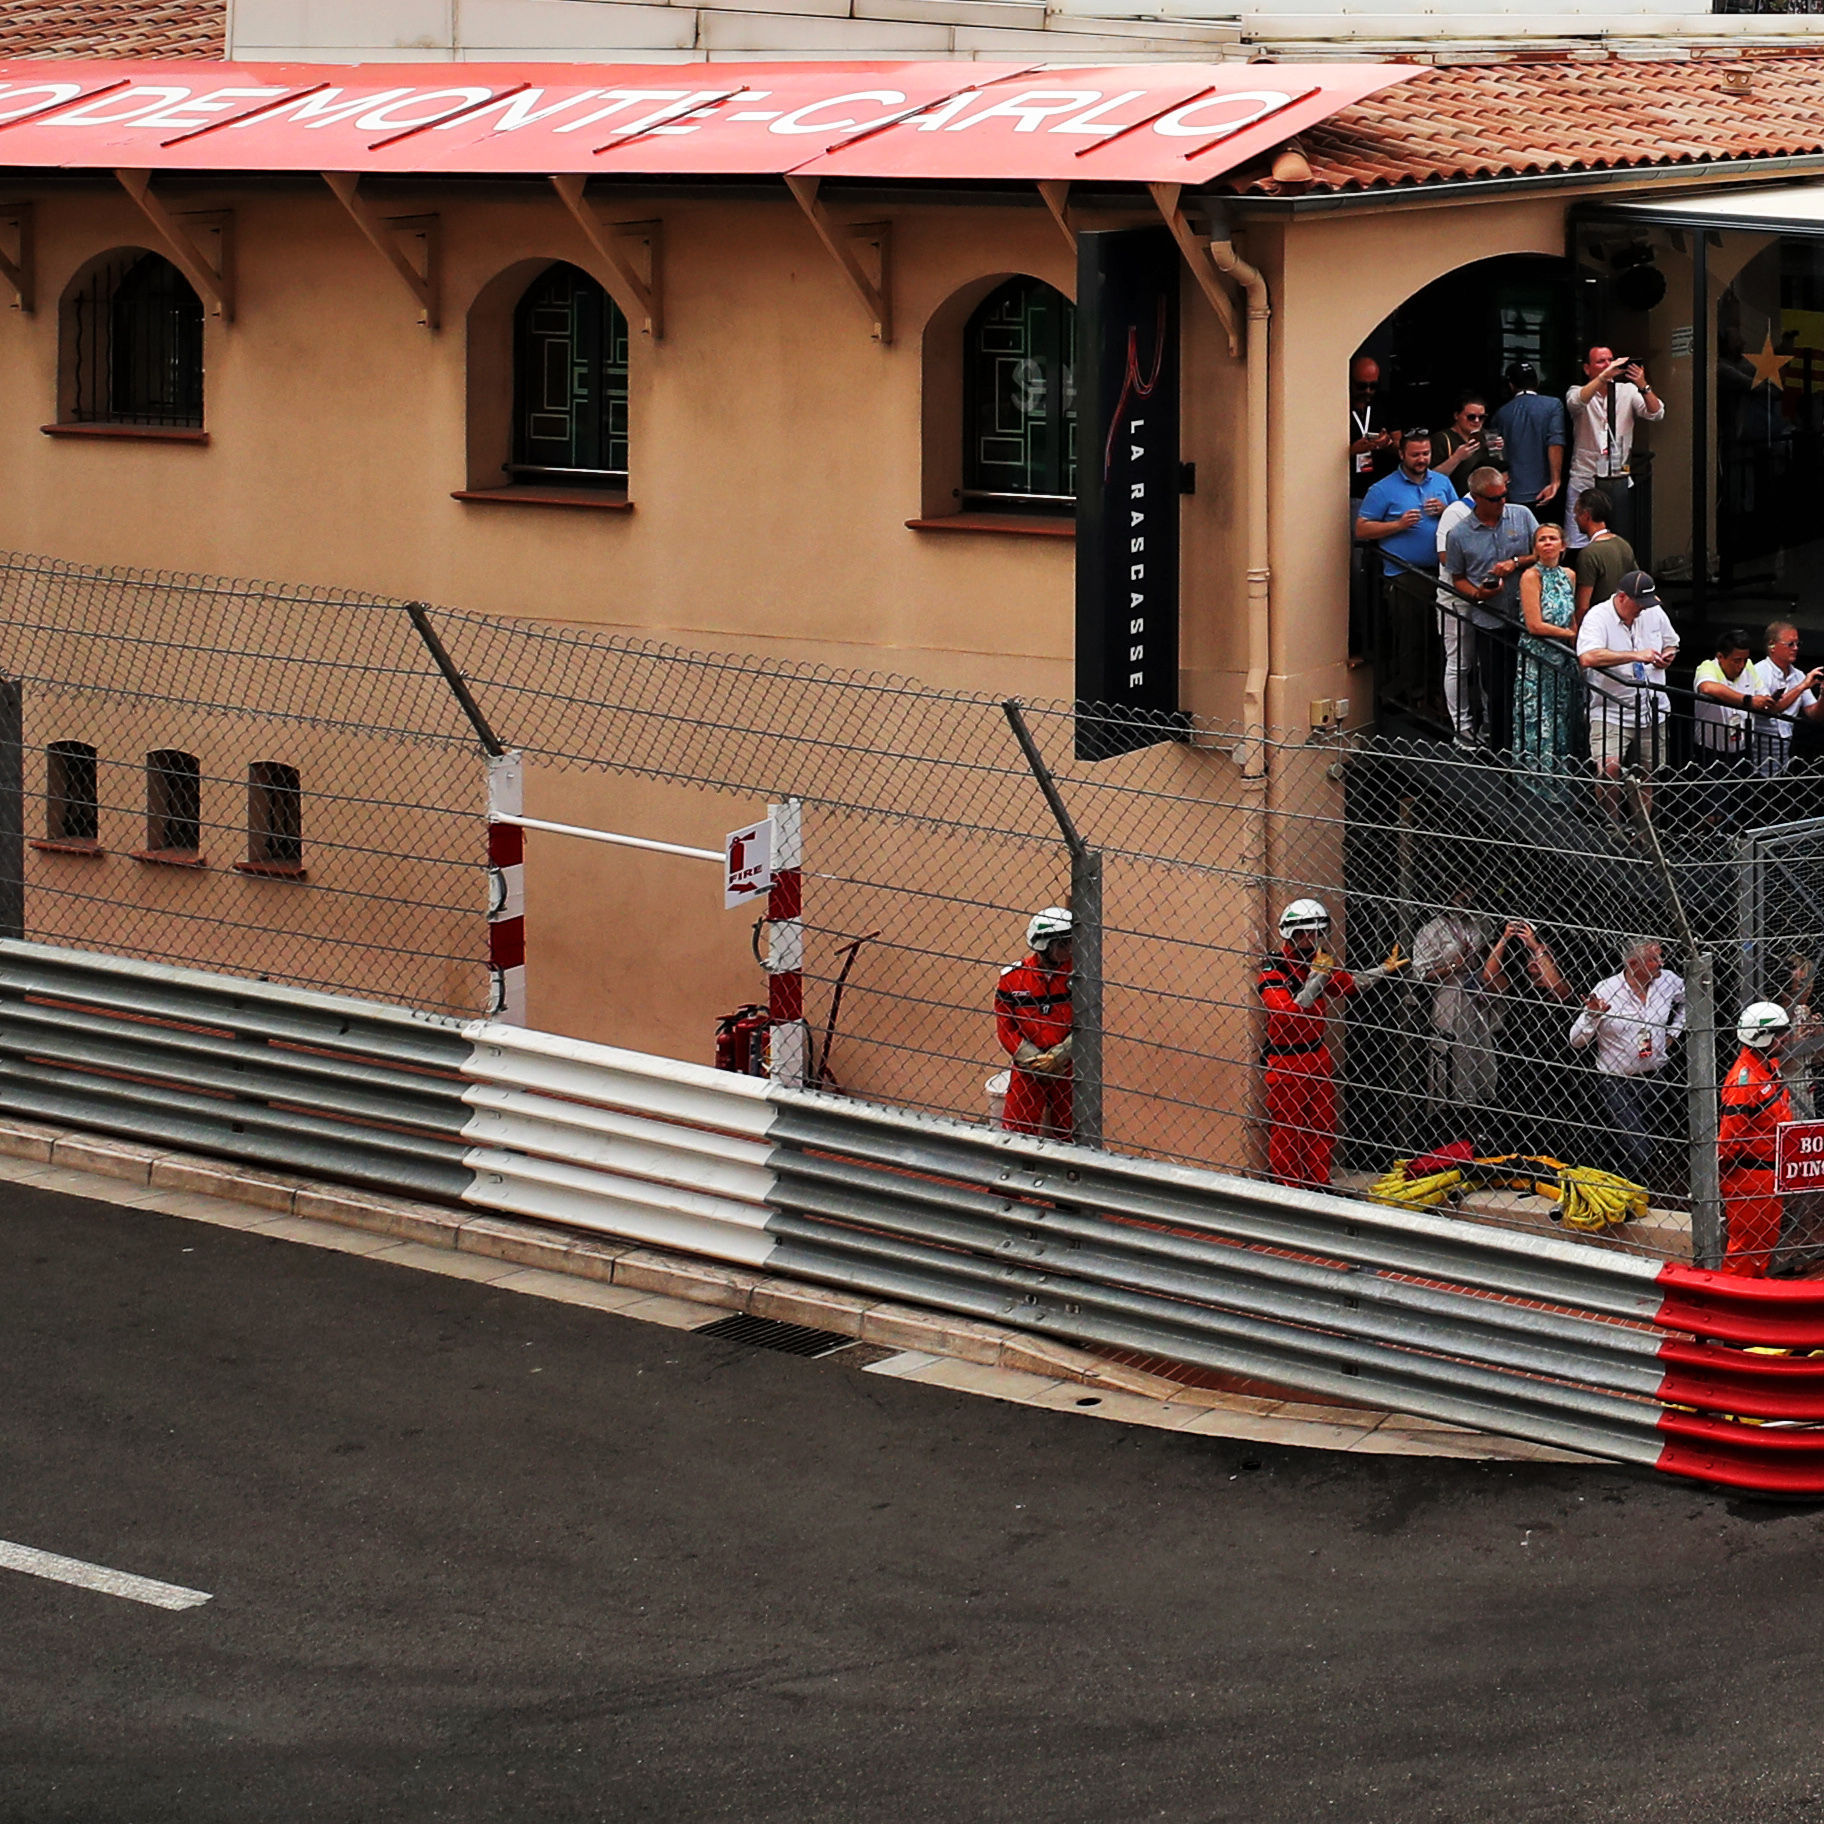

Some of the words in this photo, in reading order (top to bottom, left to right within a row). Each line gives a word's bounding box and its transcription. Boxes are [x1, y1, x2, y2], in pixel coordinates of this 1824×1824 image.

[36, 86, 288, 129] DE
[230, 87, 1293, 138] MONTE-CARLO
[1130, 419, 1145, 462] LA
[1129, 482, 1146, 688] RASCASSE
[729, 864, 763, 884] FIRE
